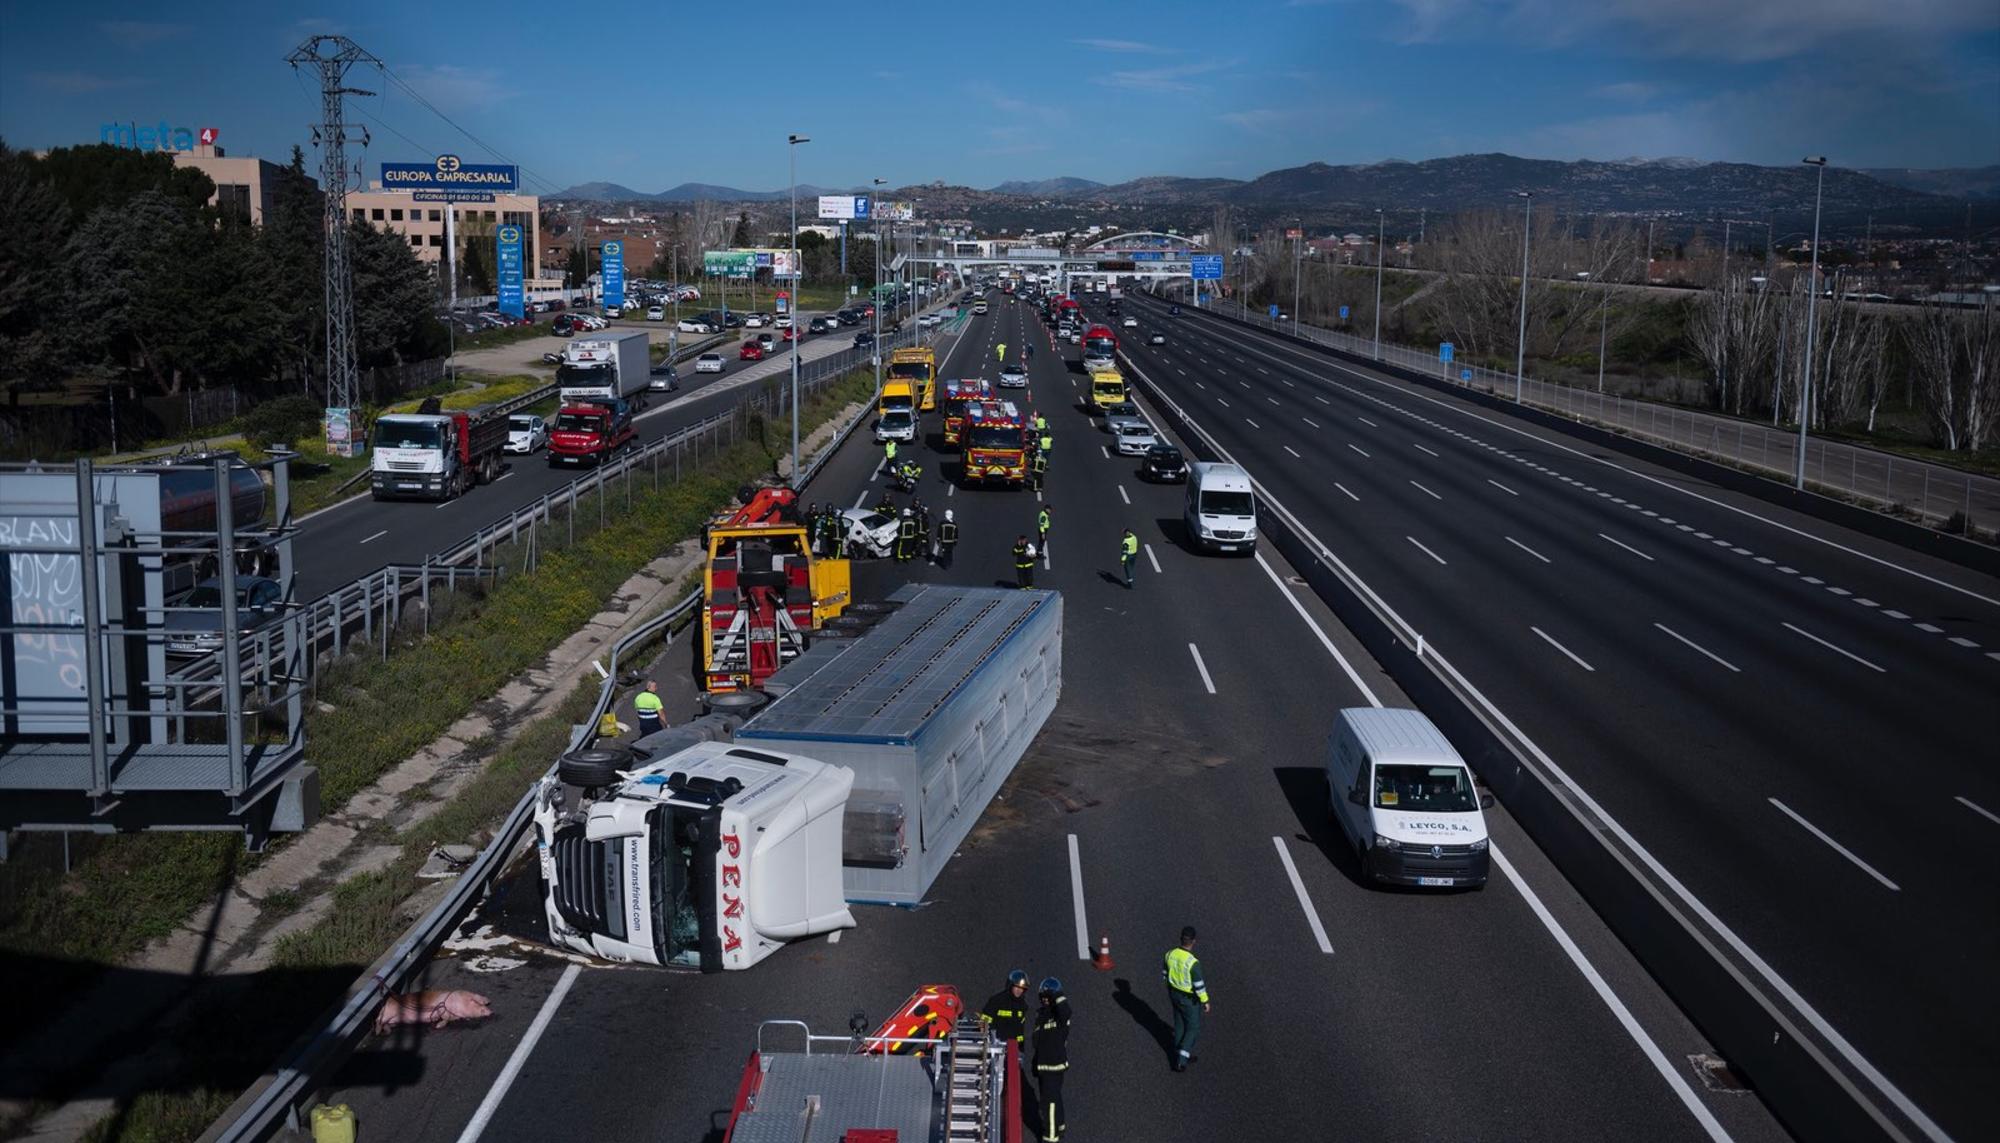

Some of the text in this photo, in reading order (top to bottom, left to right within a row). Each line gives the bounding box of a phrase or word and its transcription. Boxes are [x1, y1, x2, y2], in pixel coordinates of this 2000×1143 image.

[100, 121, 213, 150] meta 4
[385, 171, 512, 183] EUROPA EMPRESARIAL
[1410, 822, 1449, 831] LEYCO,
[722, 833, 745, 953] PEÑA
